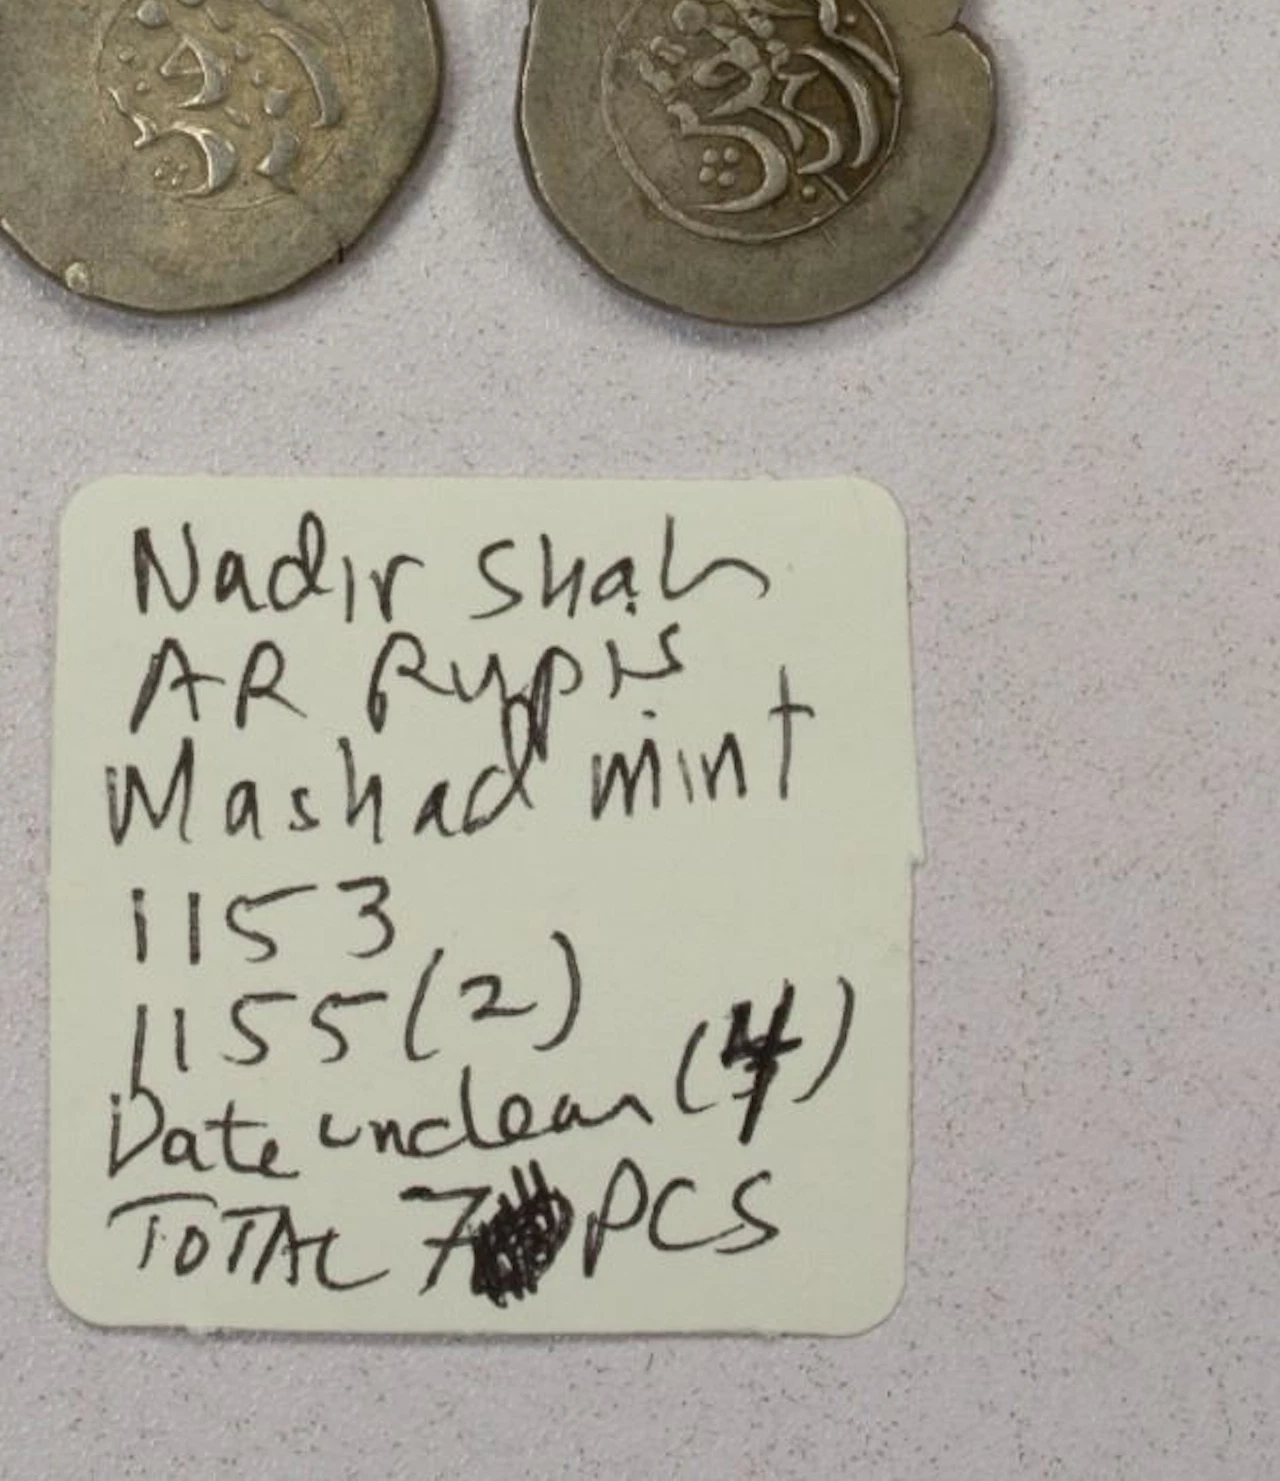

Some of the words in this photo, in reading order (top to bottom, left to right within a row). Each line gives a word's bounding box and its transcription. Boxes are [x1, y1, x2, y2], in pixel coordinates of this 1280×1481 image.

[133, 509, 425, 624] Nadir
[128, 637, 309, 734] AR
[105, 693, 538, 847] Mashad
[592, 664, 816, 820] mint
[130, 874, 396, 965] 1153
[107, 1086, 301, 1180] Date
[107, 1191, 392, 1291] TOTAL
